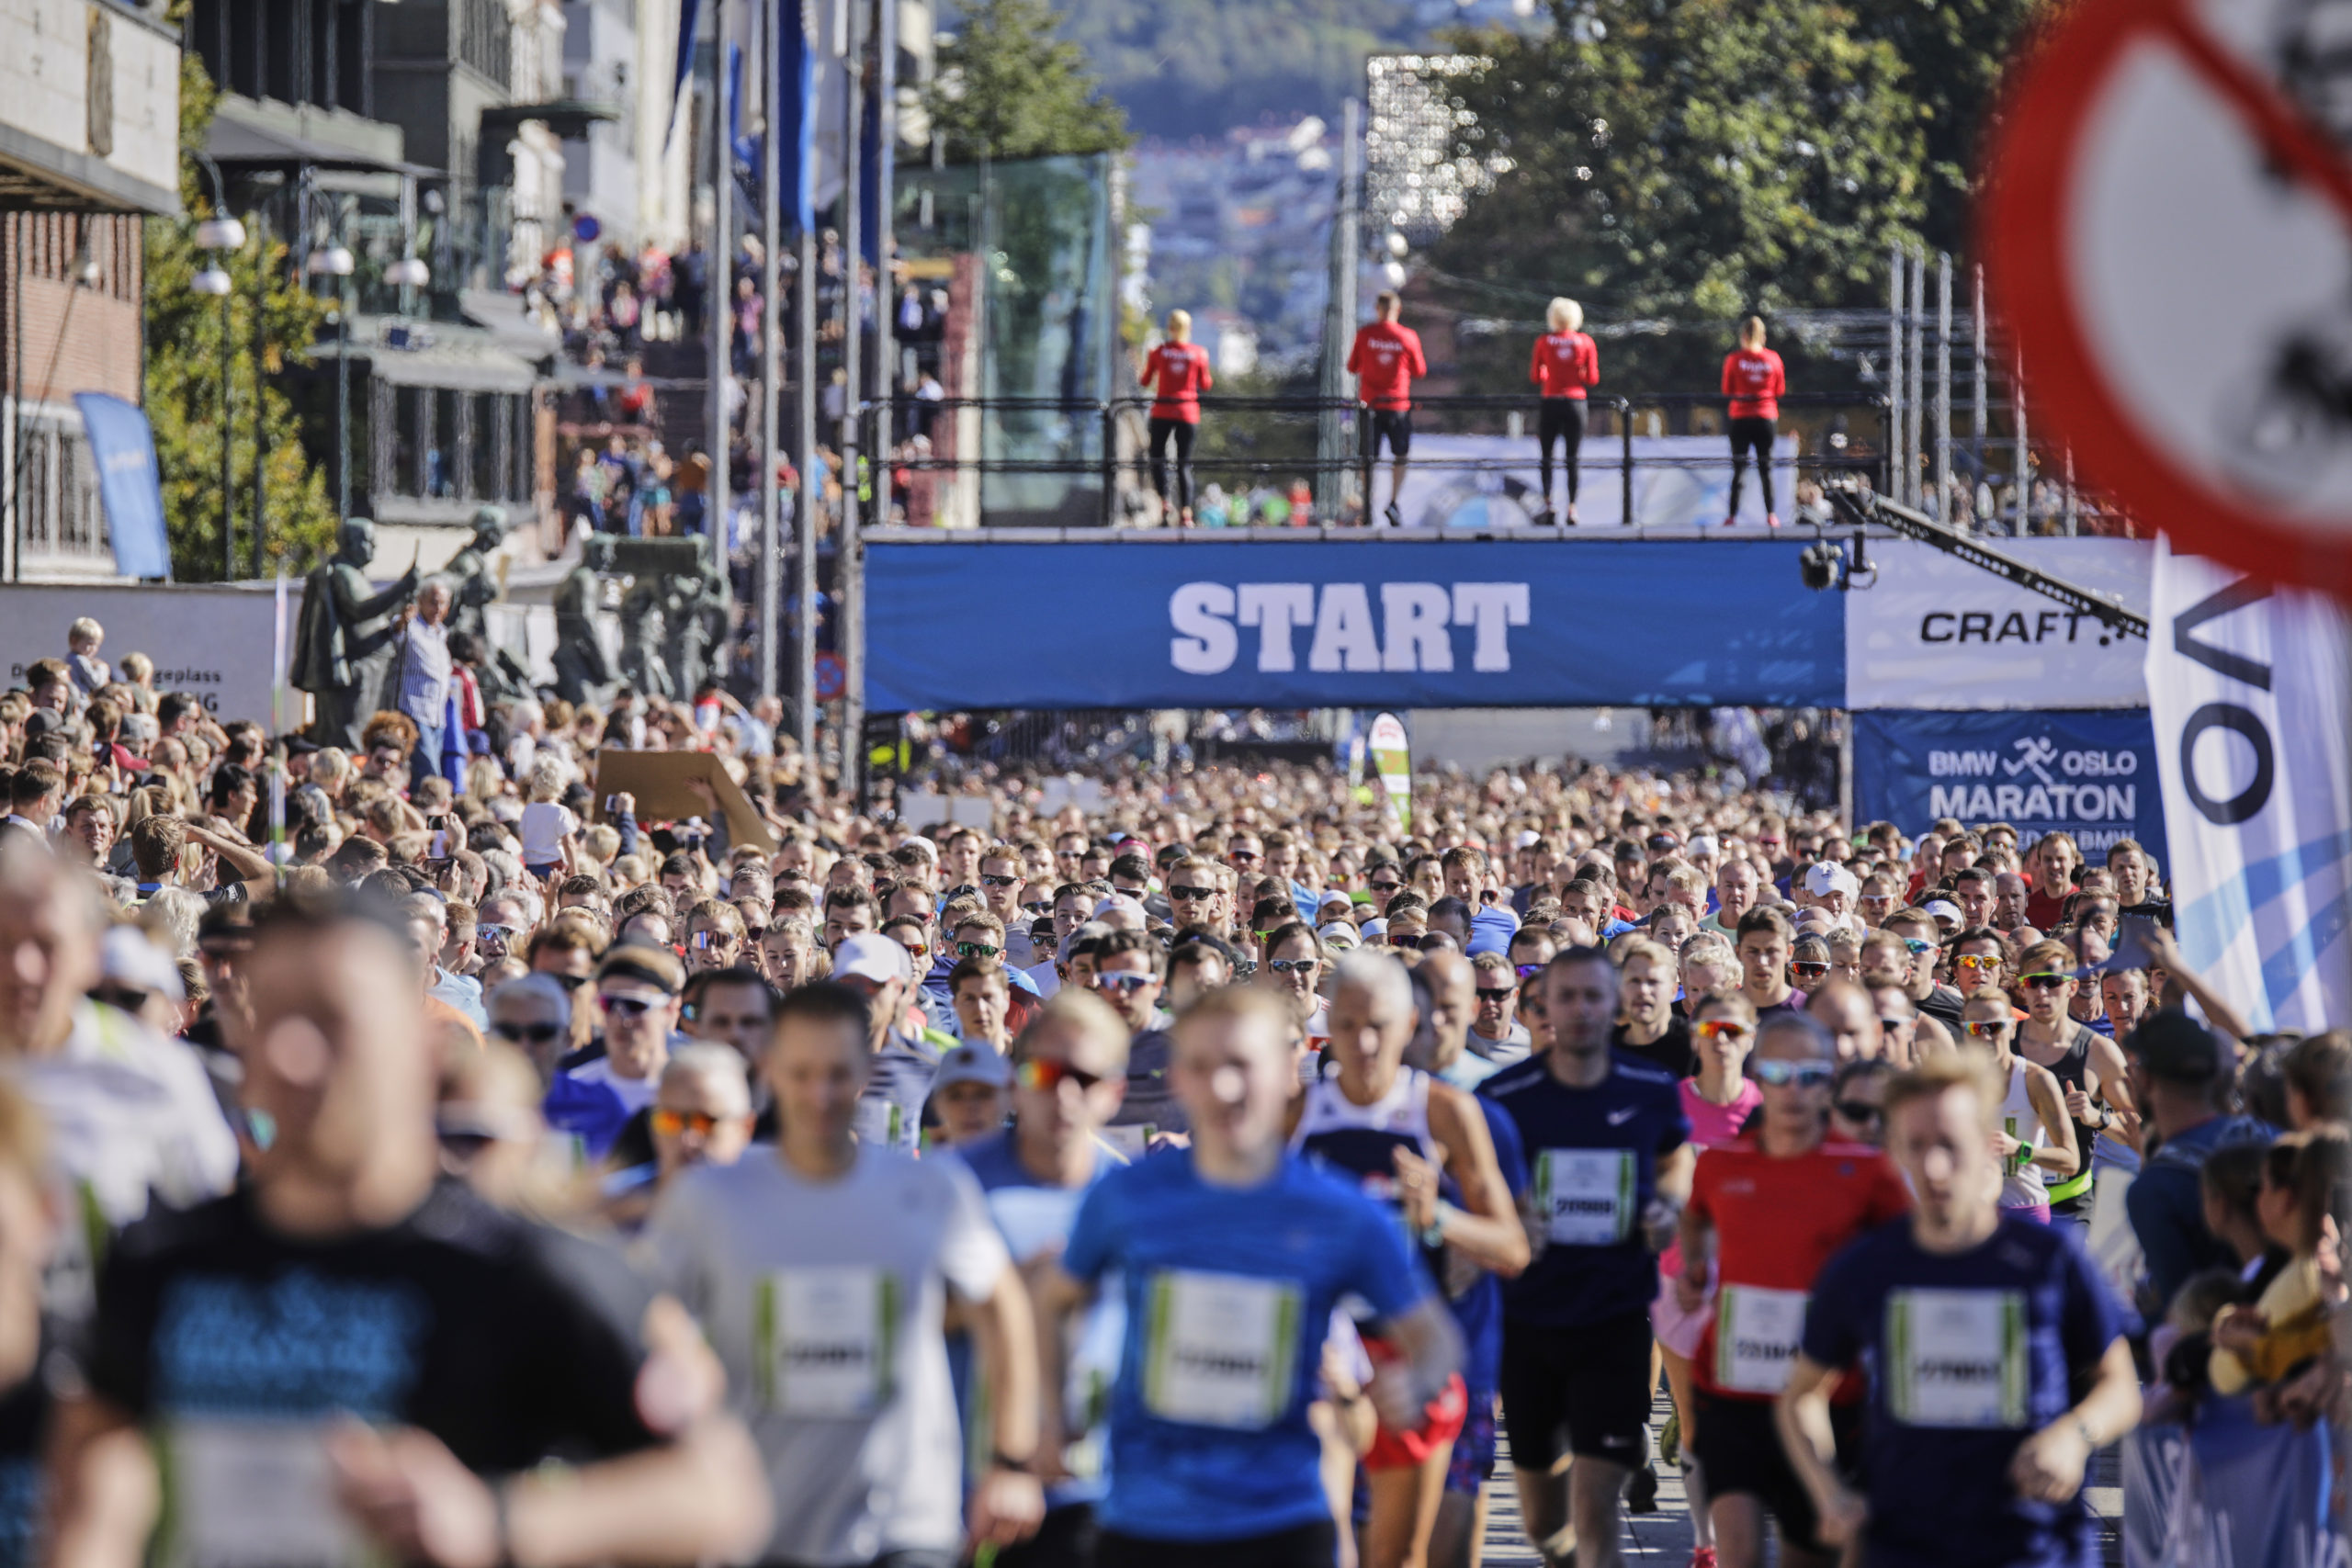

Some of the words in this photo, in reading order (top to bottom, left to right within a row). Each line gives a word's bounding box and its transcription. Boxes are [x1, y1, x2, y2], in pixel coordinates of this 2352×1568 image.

[1169, 581, 1531, 675] START
[1920, 611, 2092, 643] CRAFT
[153, 666, 221, 686] geplass
[2170, 544, 2276, 826] VO
[1928, 750, 1997, 777] BMW
[2061, 750, 2138, 777] OSLO
[1929, 784, 2136, 821] MARATON
